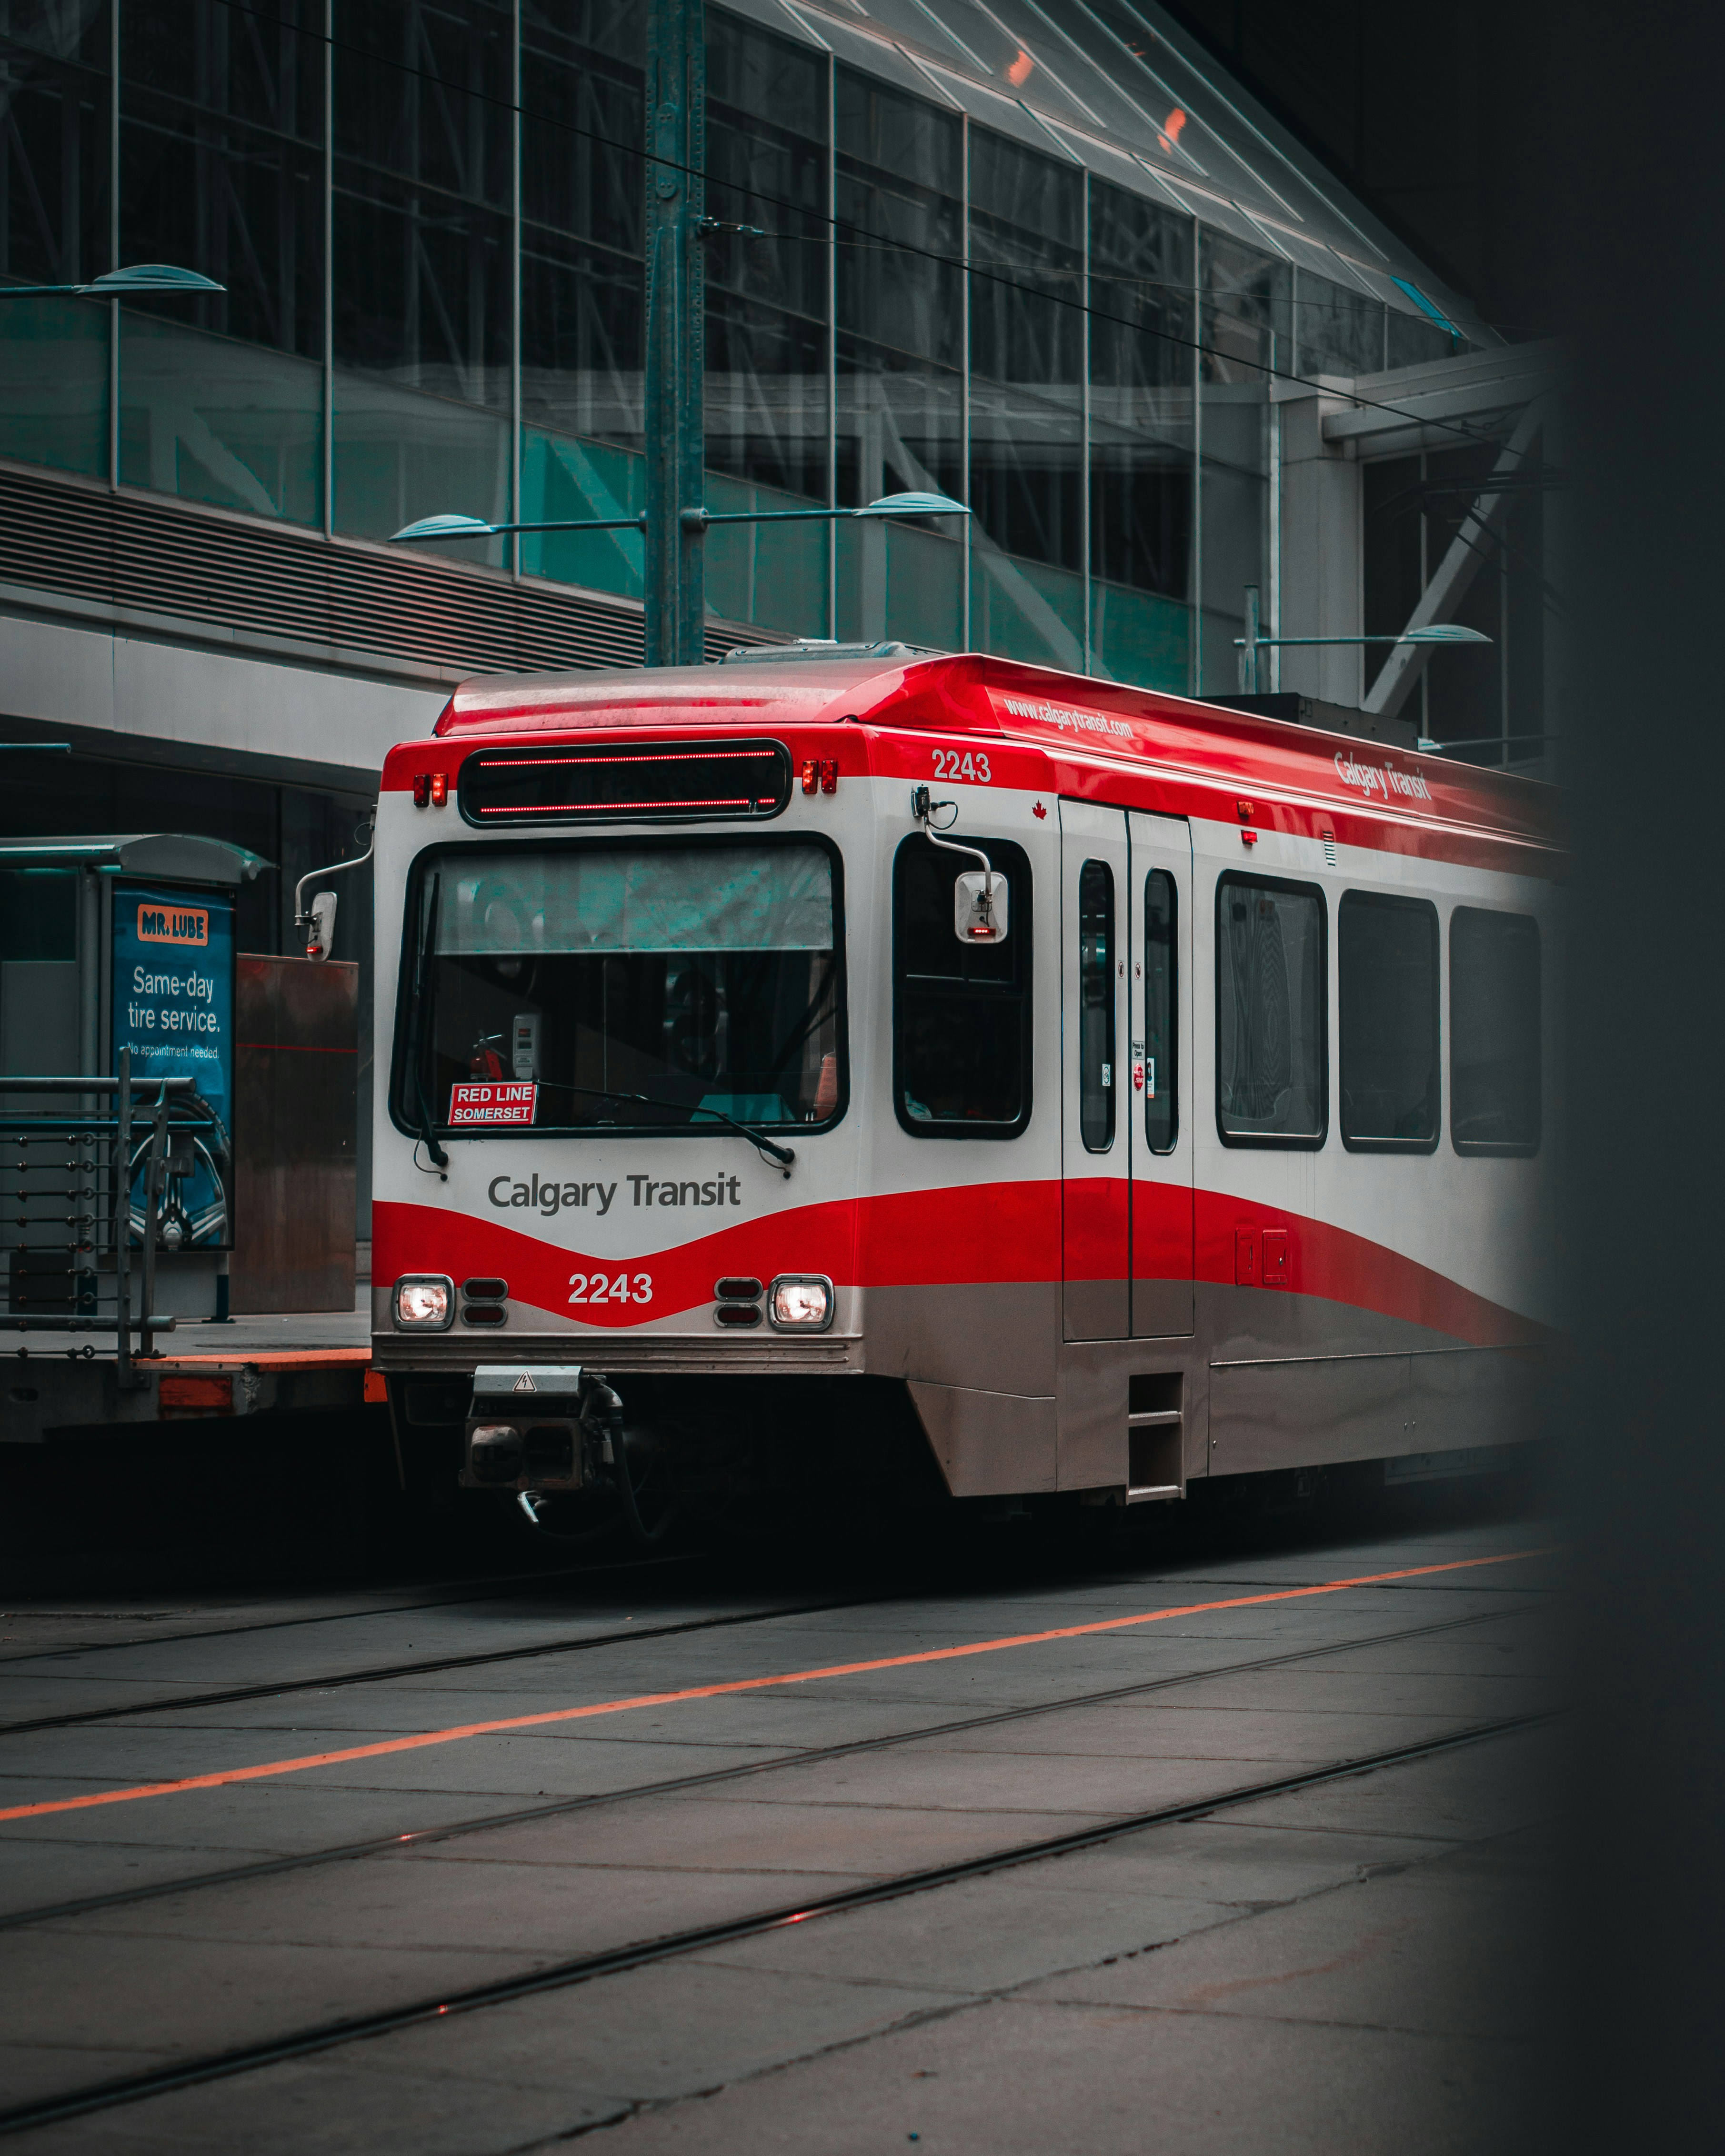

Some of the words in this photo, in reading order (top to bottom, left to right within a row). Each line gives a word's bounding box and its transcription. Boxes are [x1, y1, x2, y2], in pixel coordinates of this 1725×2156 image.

[1003, 699, 1133, 738] www.calgarytransit.com
[932, 749, 992, 782] 2243
[1334, 752, 1388, 800] Calgary
[1384, 762, 1432, 801] Transit
[142, 911, 170, 936] MR.
[172, 914, 204, 939] LUBE
[133, 966, 213, 1003] Same-day
[128, 1002, 155, 1029] tire
[161, 1005, 220, 1033] service.
[128, 1042, 139, 1055] No
[141, 1044, 188, 1058] appointment
[191, 1045, 220, 1059] needed.
[457, 1088, 491, 1102] RED
[496, 1087, 532, 1101] LINE
[454, 1107, 530, 1120] SOMERSET
[488, 1173, 618, 1216] Calgary
[626, 1172, 741, 1206] Transit
[568, 1273, 653, 1304] 2243
